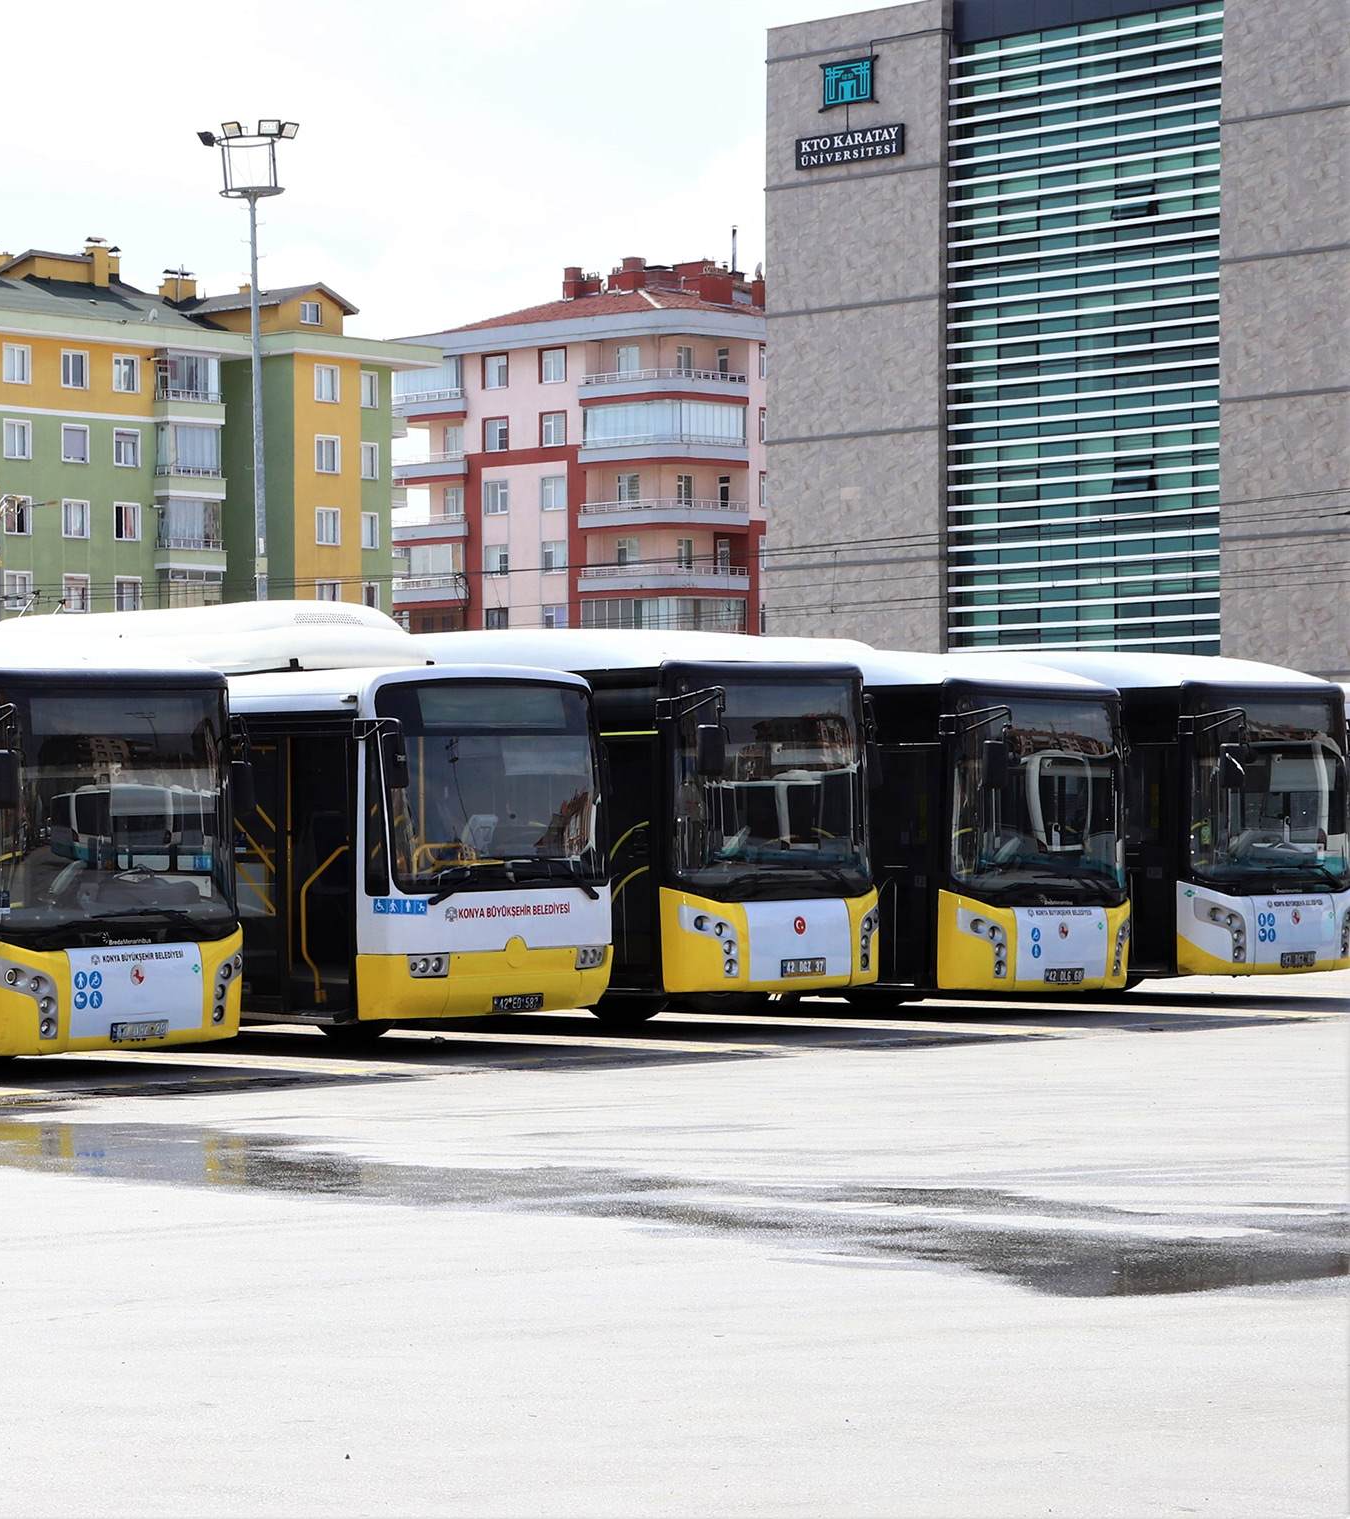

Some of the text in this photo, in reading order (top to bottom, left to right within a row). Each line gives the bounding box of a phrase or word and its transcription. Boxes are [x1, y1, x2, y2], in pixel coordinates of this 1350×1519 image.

[800, 126, 899, 153] KTO KARATAY
[801, 141, 897, 166] ÜNİVERSİTESİ
[458, 902, 571, 919] KONYA BÜYÜKŞEHİR BELEDİYESİ
[102, 948, 184, 963] KONYA BÜYÜKŞEHİR BELEDİYESİ
[786, 961, 795, 973] 42
